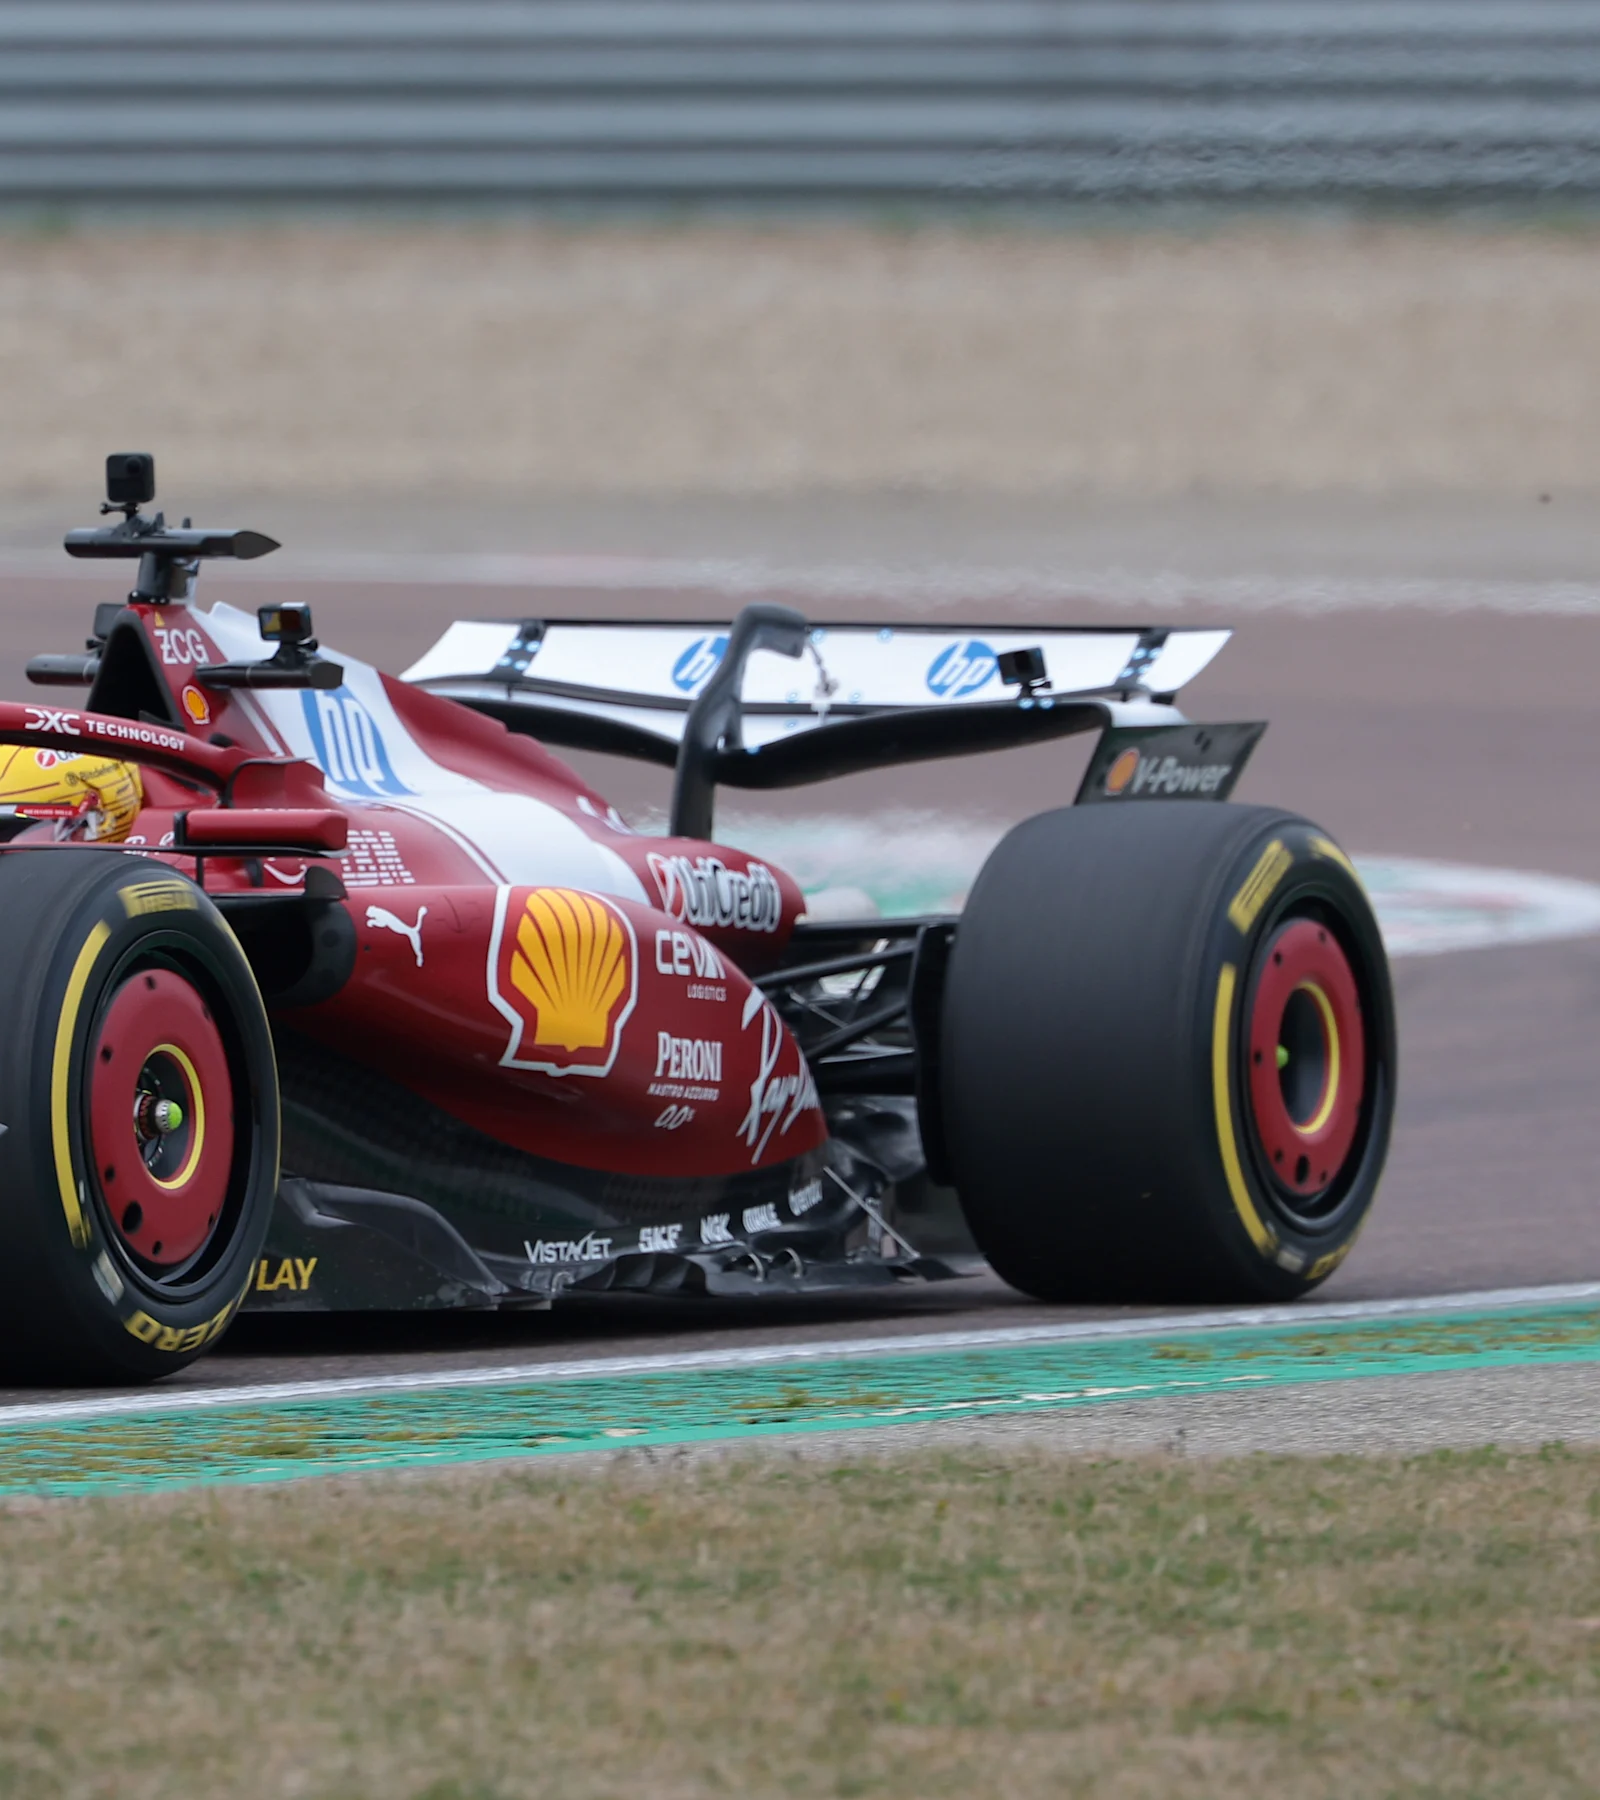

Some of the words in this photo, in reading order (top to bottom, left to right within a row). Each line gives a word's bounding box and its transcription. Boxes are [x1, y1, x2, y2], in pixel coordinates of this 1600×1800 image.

[926, 639, 1000, 698] hp
[25, 708, 81, 736] DXC
[85, 719, 185, 751] TECHNOLOGY
[1131, 756, 1231, 795] V-Power
[675, 856, 782, 933] UniCredit
[655, 1031, 723, 1082] PERONI
[639, 1224, 683, 1252] SKF
[701, 1213, 734, 1244] NGK
[256, 1257, 318, 1291] LAY
